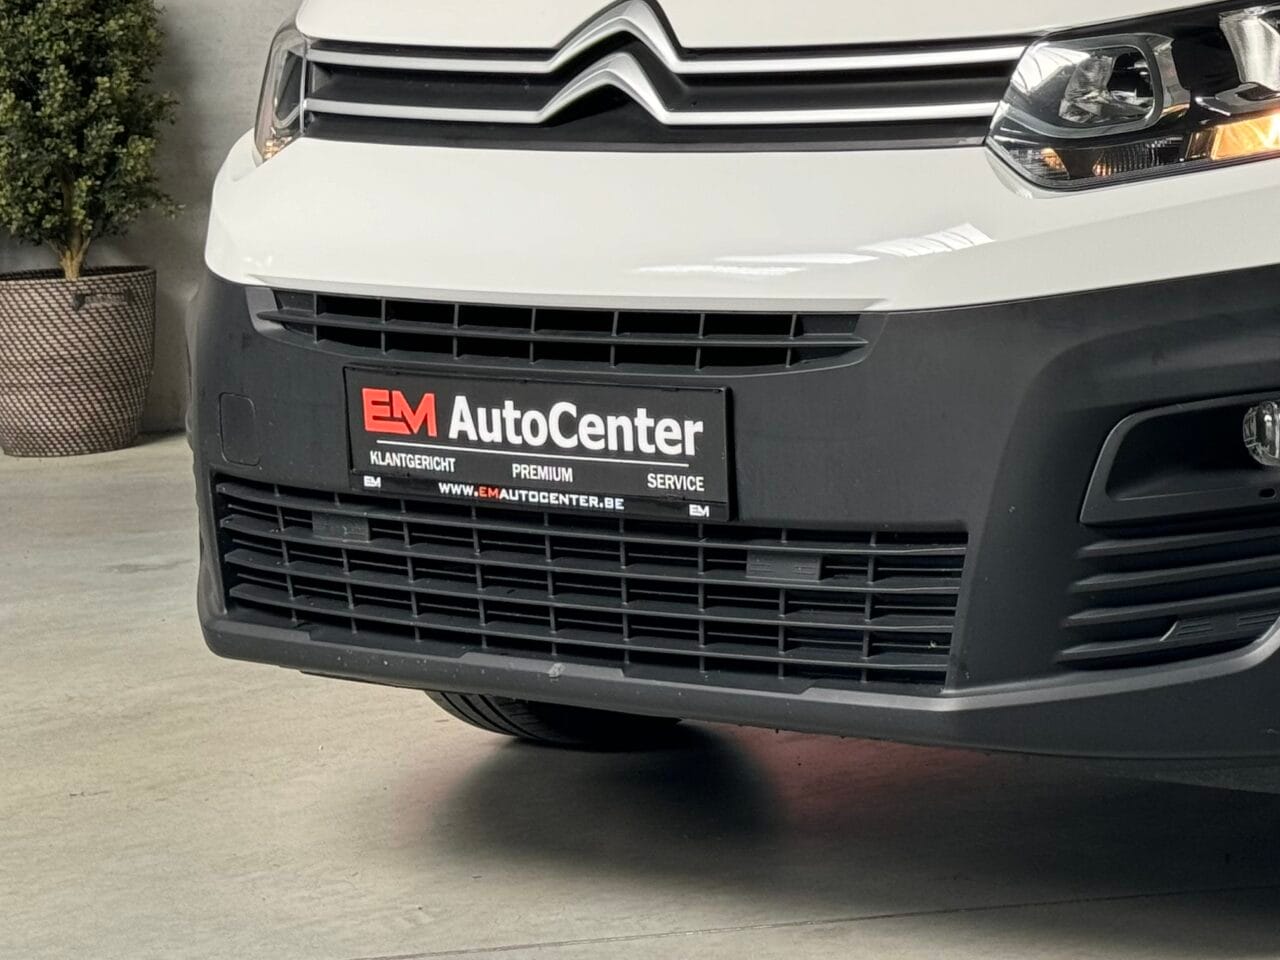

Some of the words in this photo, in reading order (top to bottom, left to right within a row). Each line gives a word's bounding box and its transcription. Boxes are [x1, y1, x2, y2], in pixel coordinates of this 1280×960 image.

[362, 388, 438, 437] EM
[448, 395, 704, 456] AutoCenter
[370, 450, 456, 473] KLANTGERICHT
[512, 463, 573, 483] PREMIUM
[647, 473, 705, 491] SERVICE
[363, 475, 382, 489] EM
[438, 482, 625, 510] WWW.EMAUTOCENTER.BE
[688, 503, 710, 518] EM
